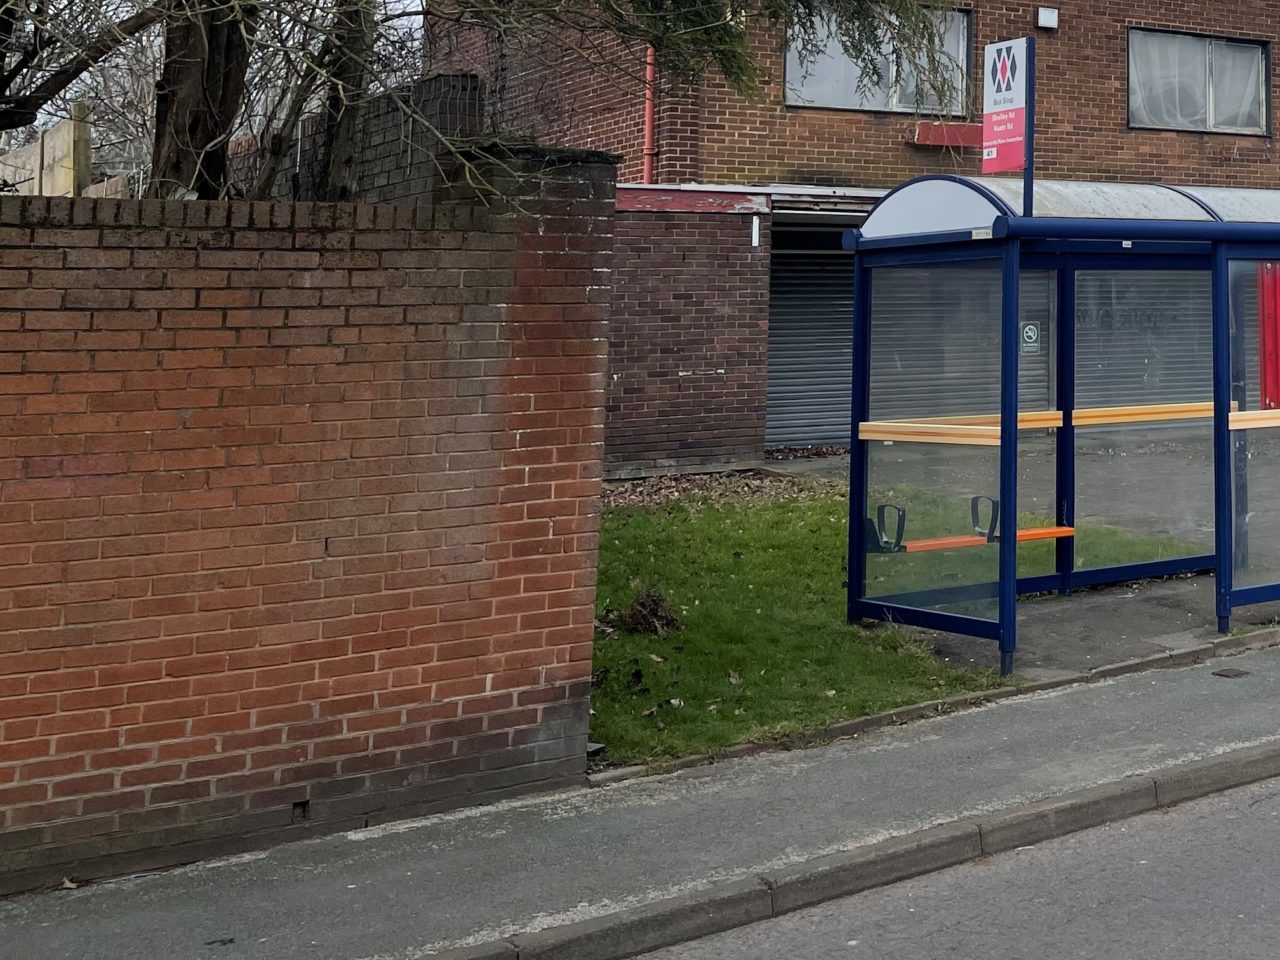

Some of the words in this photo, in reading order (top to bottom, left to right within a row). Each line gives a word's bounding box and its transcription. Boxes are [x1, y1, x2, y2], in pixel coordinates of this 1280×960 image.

[1003, 97, 1014, 105] Stop
[992, 113, 1008, 121] Shelley
[986, 149, 993, 157] 41
